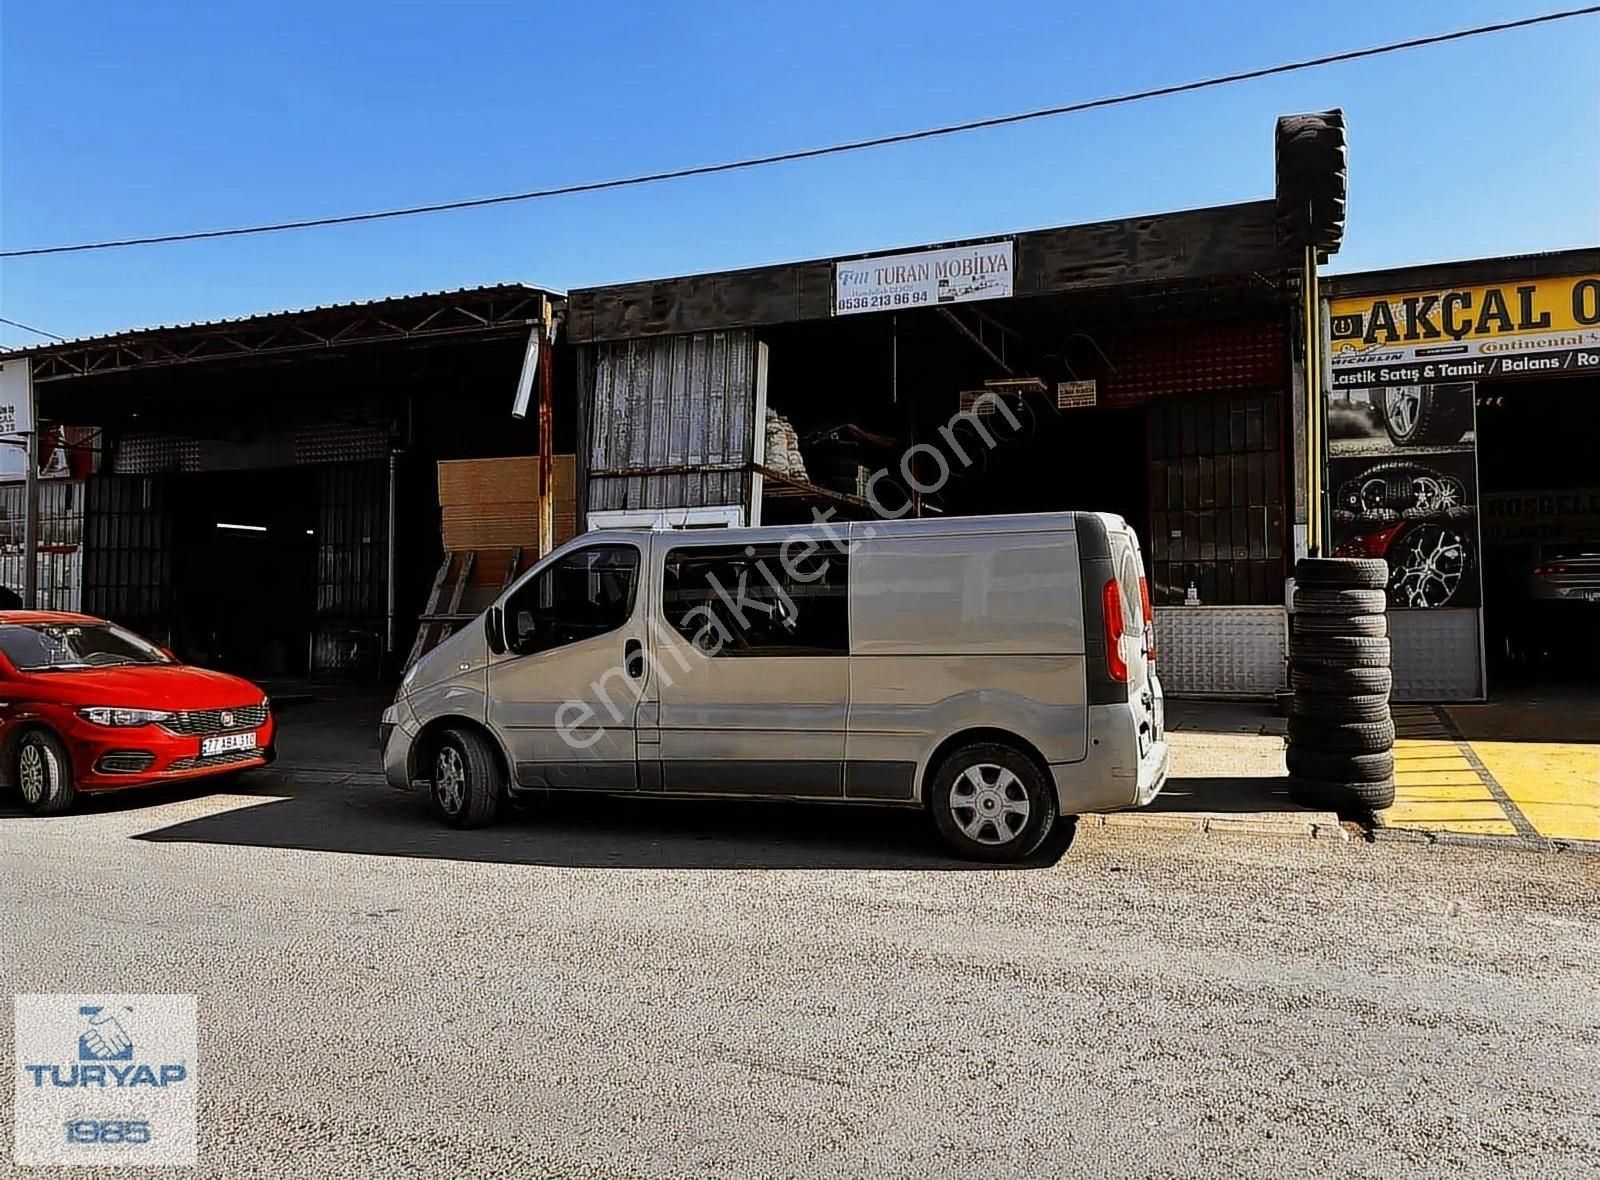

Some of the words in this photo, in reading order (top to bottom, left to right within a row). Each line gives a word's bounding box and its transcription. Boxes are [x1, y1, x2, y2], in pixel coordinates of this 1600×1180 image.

[874, 262, 930, 286] TURAN
[935, 252, 1009, 280] MOBİLYA
[838, 296, 869, 310] 0536
[871, 294, 892, 307] 213
[1363, 285, 1551, 344] AKÇAL
[1479, 335, 1583, 354] Continental
[1332, 370, 1376, 385] Lastik
[1380, 368, 1420, 383] Satış
[1423, 366, 1435, 378] &
[1438, 362, 1485, 377] Tamir
[1501, 356, 1560, 372] Balans
[1577, 351, 1600, 367] Ro
